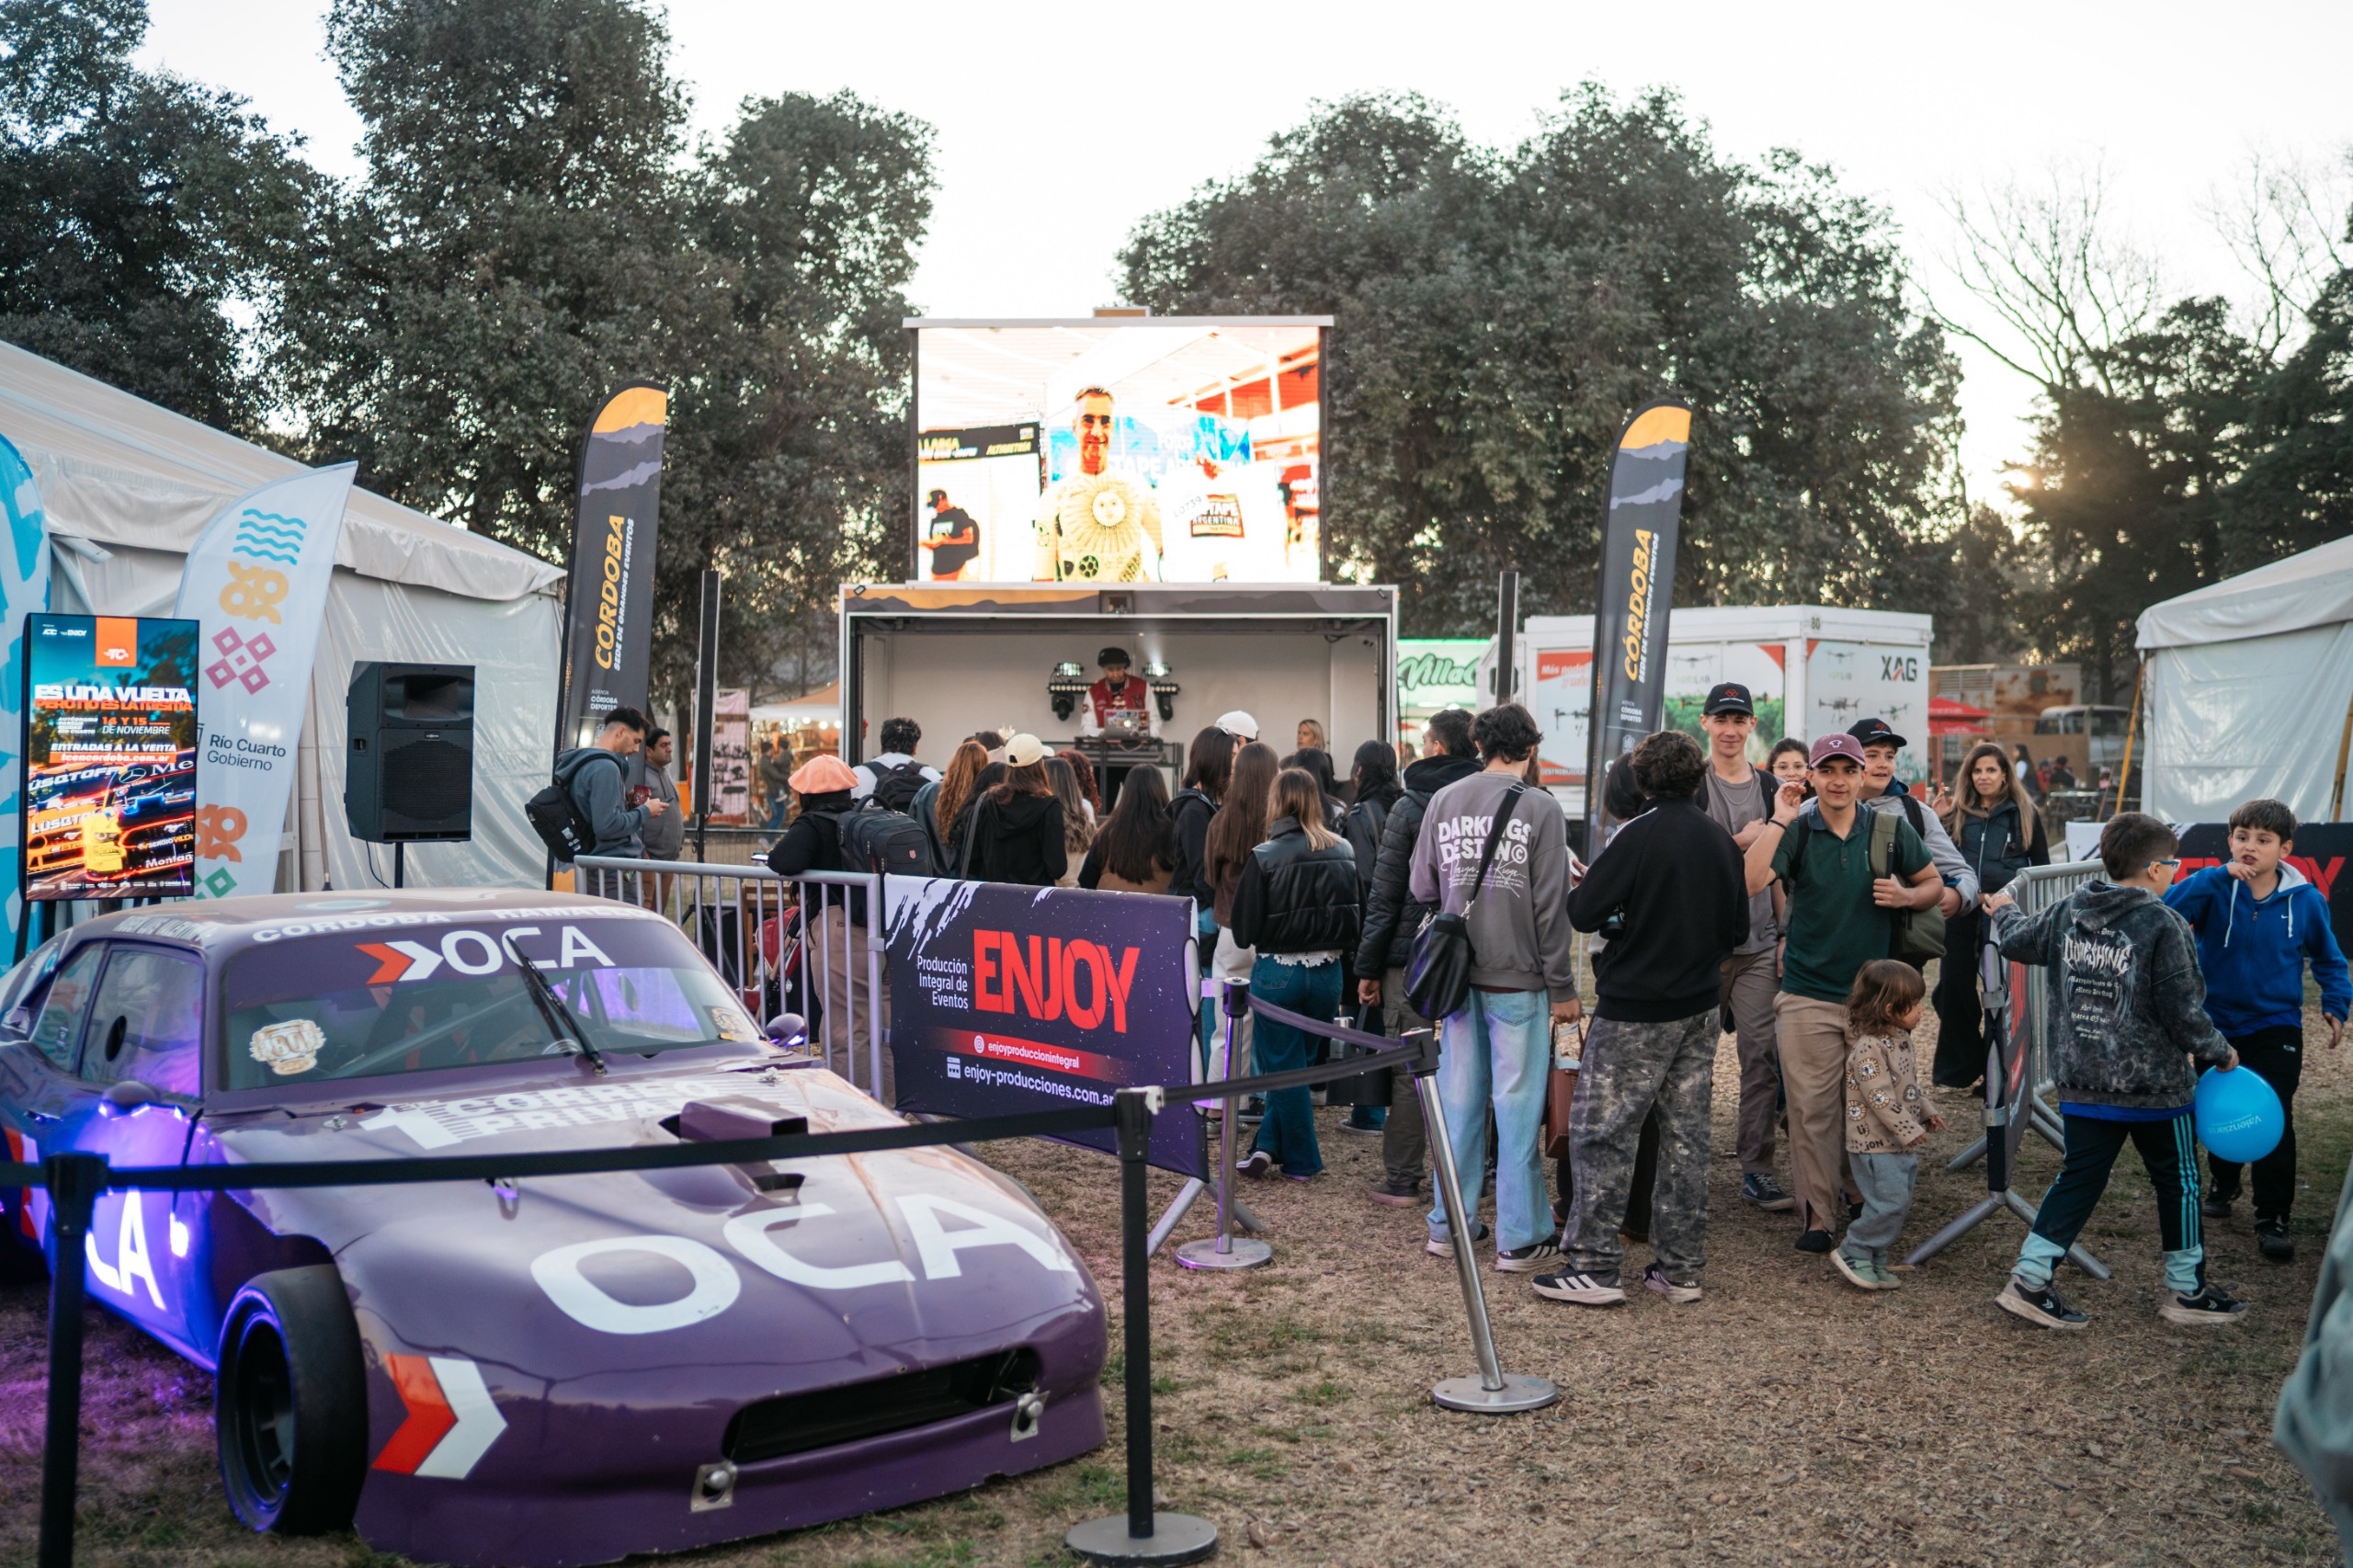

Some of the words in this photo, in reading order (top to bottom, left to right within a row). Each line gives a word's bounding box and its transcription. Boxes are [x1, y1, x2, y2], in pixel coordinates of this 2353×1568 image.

[1206, 502, 1239, 517] TAPE
[624, 517, 634, 570] EVENTOS
[1649, 532, 1660, 584] EVENTOS
[595, 515, 625, 670] CÓRDOBA
[619, 570, 629, 625] GRANDES
[1623, 528, 1652, 681] CÓRDOBA
[1643, 584, 1654, 638] GRANDES
[617, 626, 623, 642] DE
[1642, 638, 1648, 654] DE
[614, 643, 622, 671] SEDE
[1639, 656, 1647, 684] SEDE
[1881, 655, 1917, 682] XAG
[35, 685, 63, 700] ES
[65, 686, 114, 701] UNA
[115, 687, 192, 703] VUELTA
[35, 699, 75, 710] PERO
[77, 699, 98, 710] NO
[101, 699, 119, 710] ES
[120, 700, 138, 710] LA
[140, 701, 193, 712] MISMA
[102, 717, 118, 725] 14
[120, 717, 131, 725] Y
[133, 717, 148, 725] 15
[102, 726, 114, 734] DE
[117, 726, 171, 734] NOVIEMBRE
[51, 743, 112, 752] ENTRADAS
[113, 744, 122, 752] A
[125, 744, 138, 752] LA
[142, 744, 176, 752] VENTA
[61, 753, 170, 762] tcencordoba.com.ar
[210, 734, 233, 749] Río
[236, 739, 286, 757] Cuarto
[207, 750, 272, 771] Gobierno
[1438, 815, 1531, 844] DARKIGS
[252, 913, 452, 943] CORDOBA
[493, 905, 651, 919] RAMALLO
[442, 926, 617, 975] OCA
[916, 954, 968, 976] Producción
[918, 973, 954, 992] Integral
[956, 977, 968, 993] de
[973, 928, 1141, 1034] ENJOY
[931, 991, 969, 1010] Eventos
[987, 1040, 1080, 1070] enjoyproduccionintegral
[446, 1080, 722, 1117] CORREO
[963, 1063, 1115, 1107] enjoy-producciones.com.ar
[470, 1097, 686, 1135] PRIVA
[530, 1194, 1077, 1335] OCA
